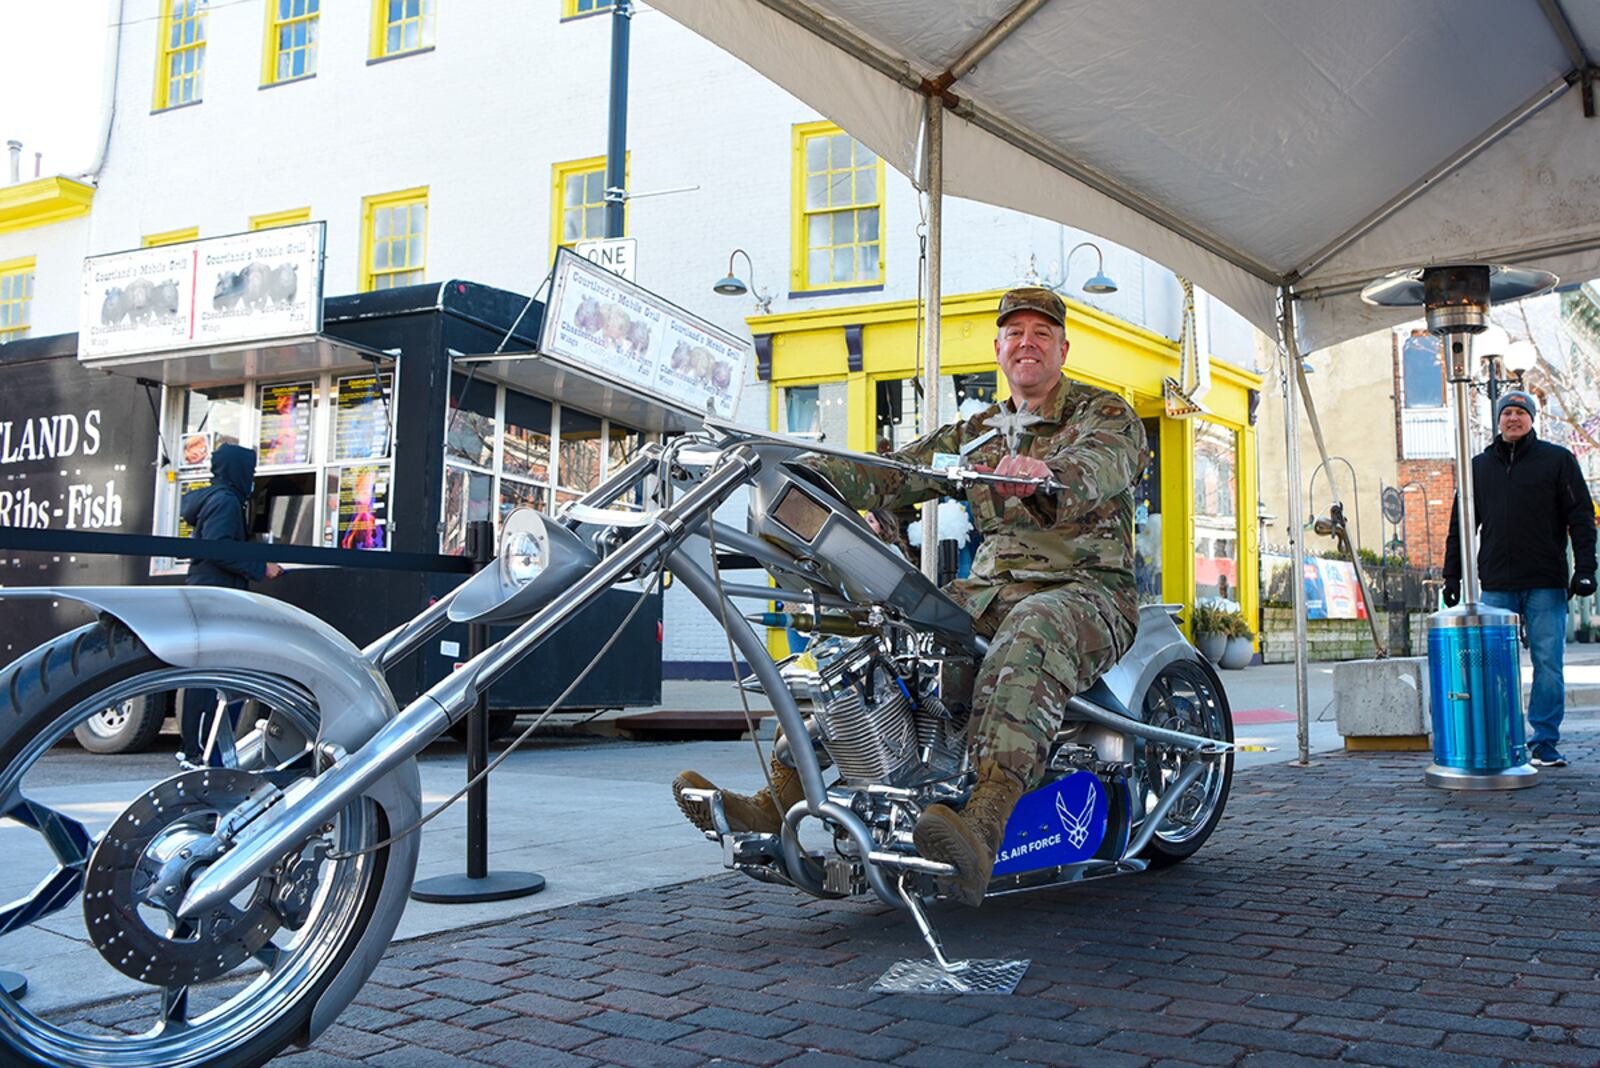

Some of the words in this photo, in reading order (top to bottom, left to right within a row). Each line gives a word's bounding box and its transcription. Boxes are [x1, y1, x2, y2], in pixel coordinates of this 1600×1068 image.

[588, 246, 626, 265] ONE
[0, 409, 101, 465] LANDS
[1010, 844, 1028, 859] AIR
[1029, 833, 1061, 852] FORCE
